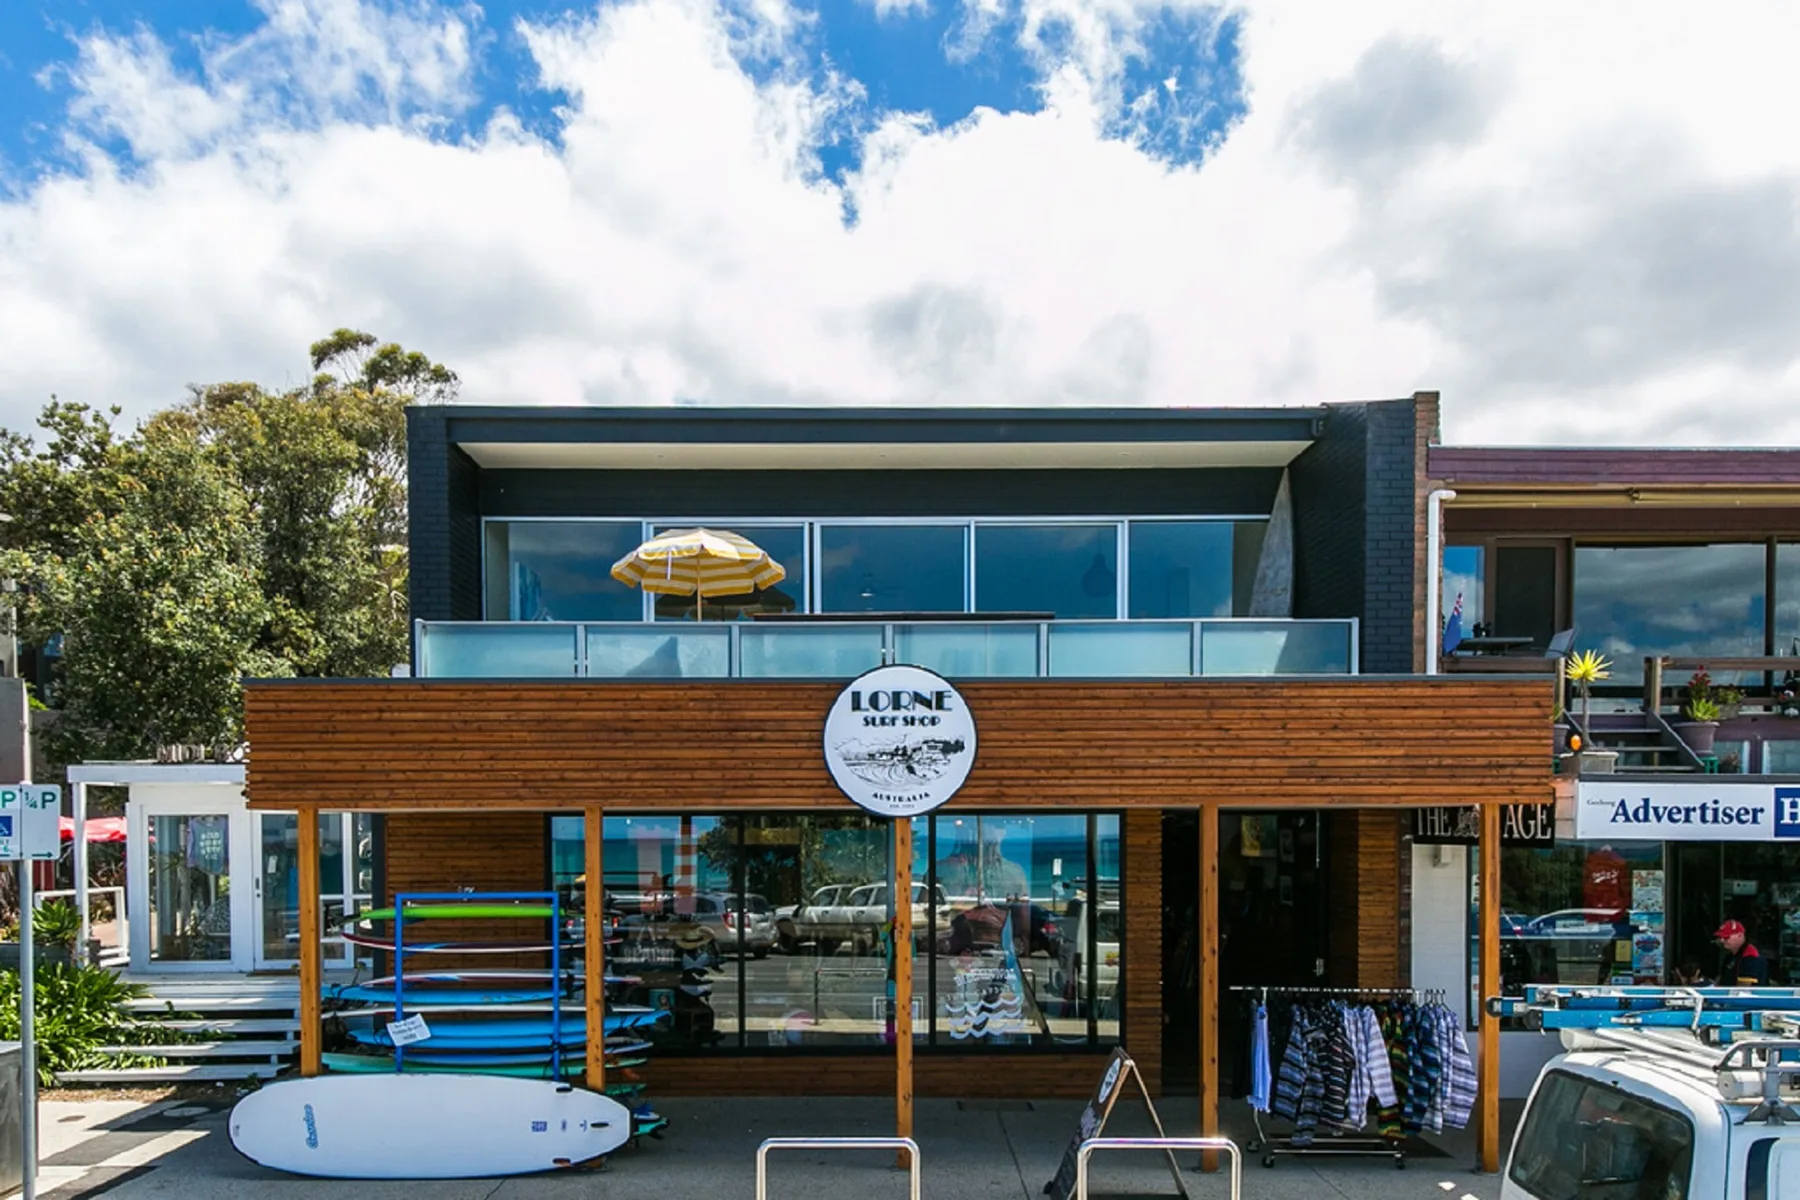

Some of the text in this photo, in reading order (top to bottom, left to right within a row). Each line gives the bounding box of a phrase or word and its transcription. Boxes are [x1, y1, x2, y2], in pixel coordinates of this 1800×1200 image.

[851, 690, 953, 712] LORNE
[862, 715, 941, 727] SURF SHOP
[872, 792, 930, 802] AUSTRALIA
[1417, 804, 1552, 839] THE AGE
[1610, 797, 1765, 825] Advertiser
